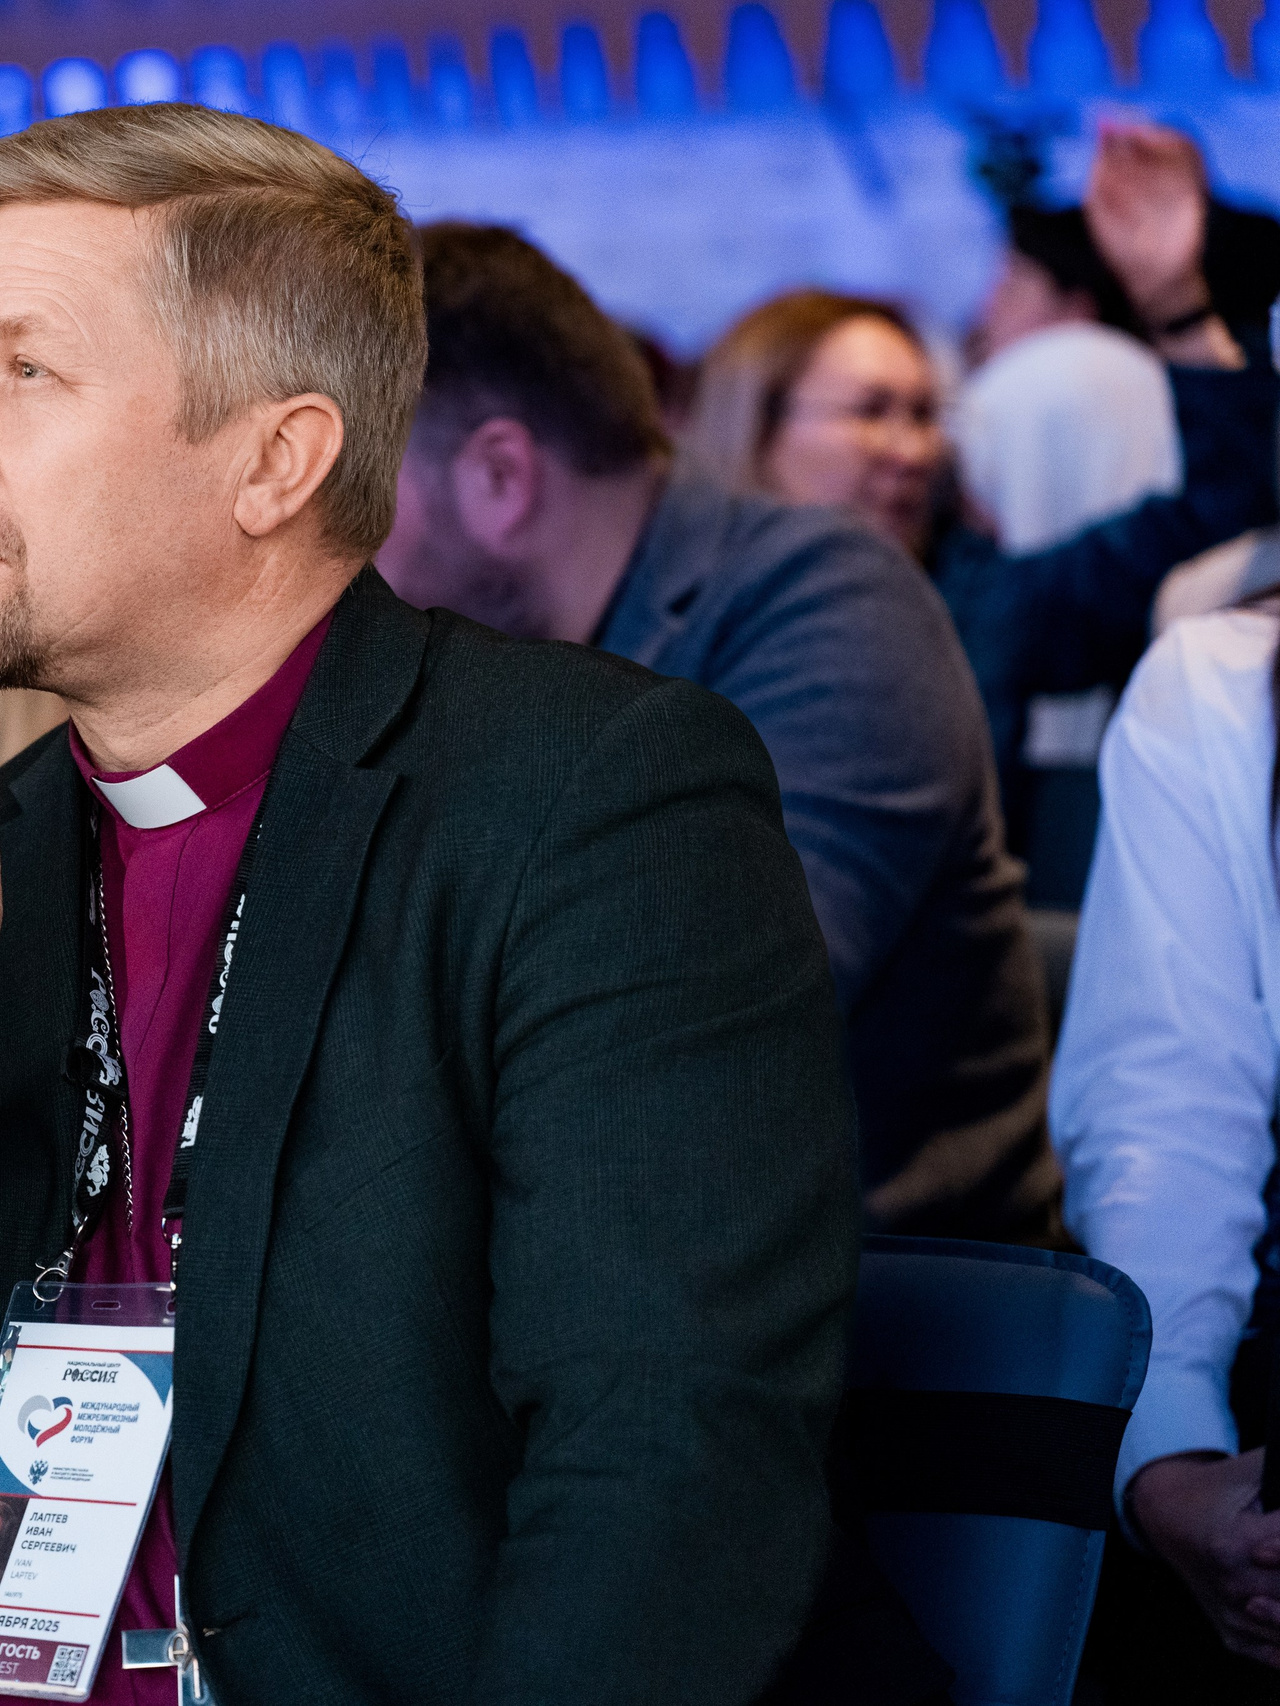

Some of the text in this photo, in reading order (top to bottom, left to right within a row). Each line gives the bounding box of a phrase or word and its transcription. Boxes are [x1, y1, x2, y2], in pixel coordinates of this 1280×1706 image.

[62, 1368, 119, 1383] РОССИЯ
[80, 1401, 140, 1411] МЕЖДУНАРОДНЫЙ
[76, 1412, 138, 1422] МЕЖРЕЛИГИОЗНЫЙ
[70, 1435, 94, 1444] ФОРУМ
[29, 1512, 68, 1524] ЛАПТЕВ
[25, 1526, 53, 1537] ИВАН
[20, 1539, 77, 1554] СЕРГЕЕВИЧ
[14, 1558, 32, 1567] IVAN
[10, 1571, 38, 1581] LAPTEV
[29, 1619, 60, 1633] 2025
